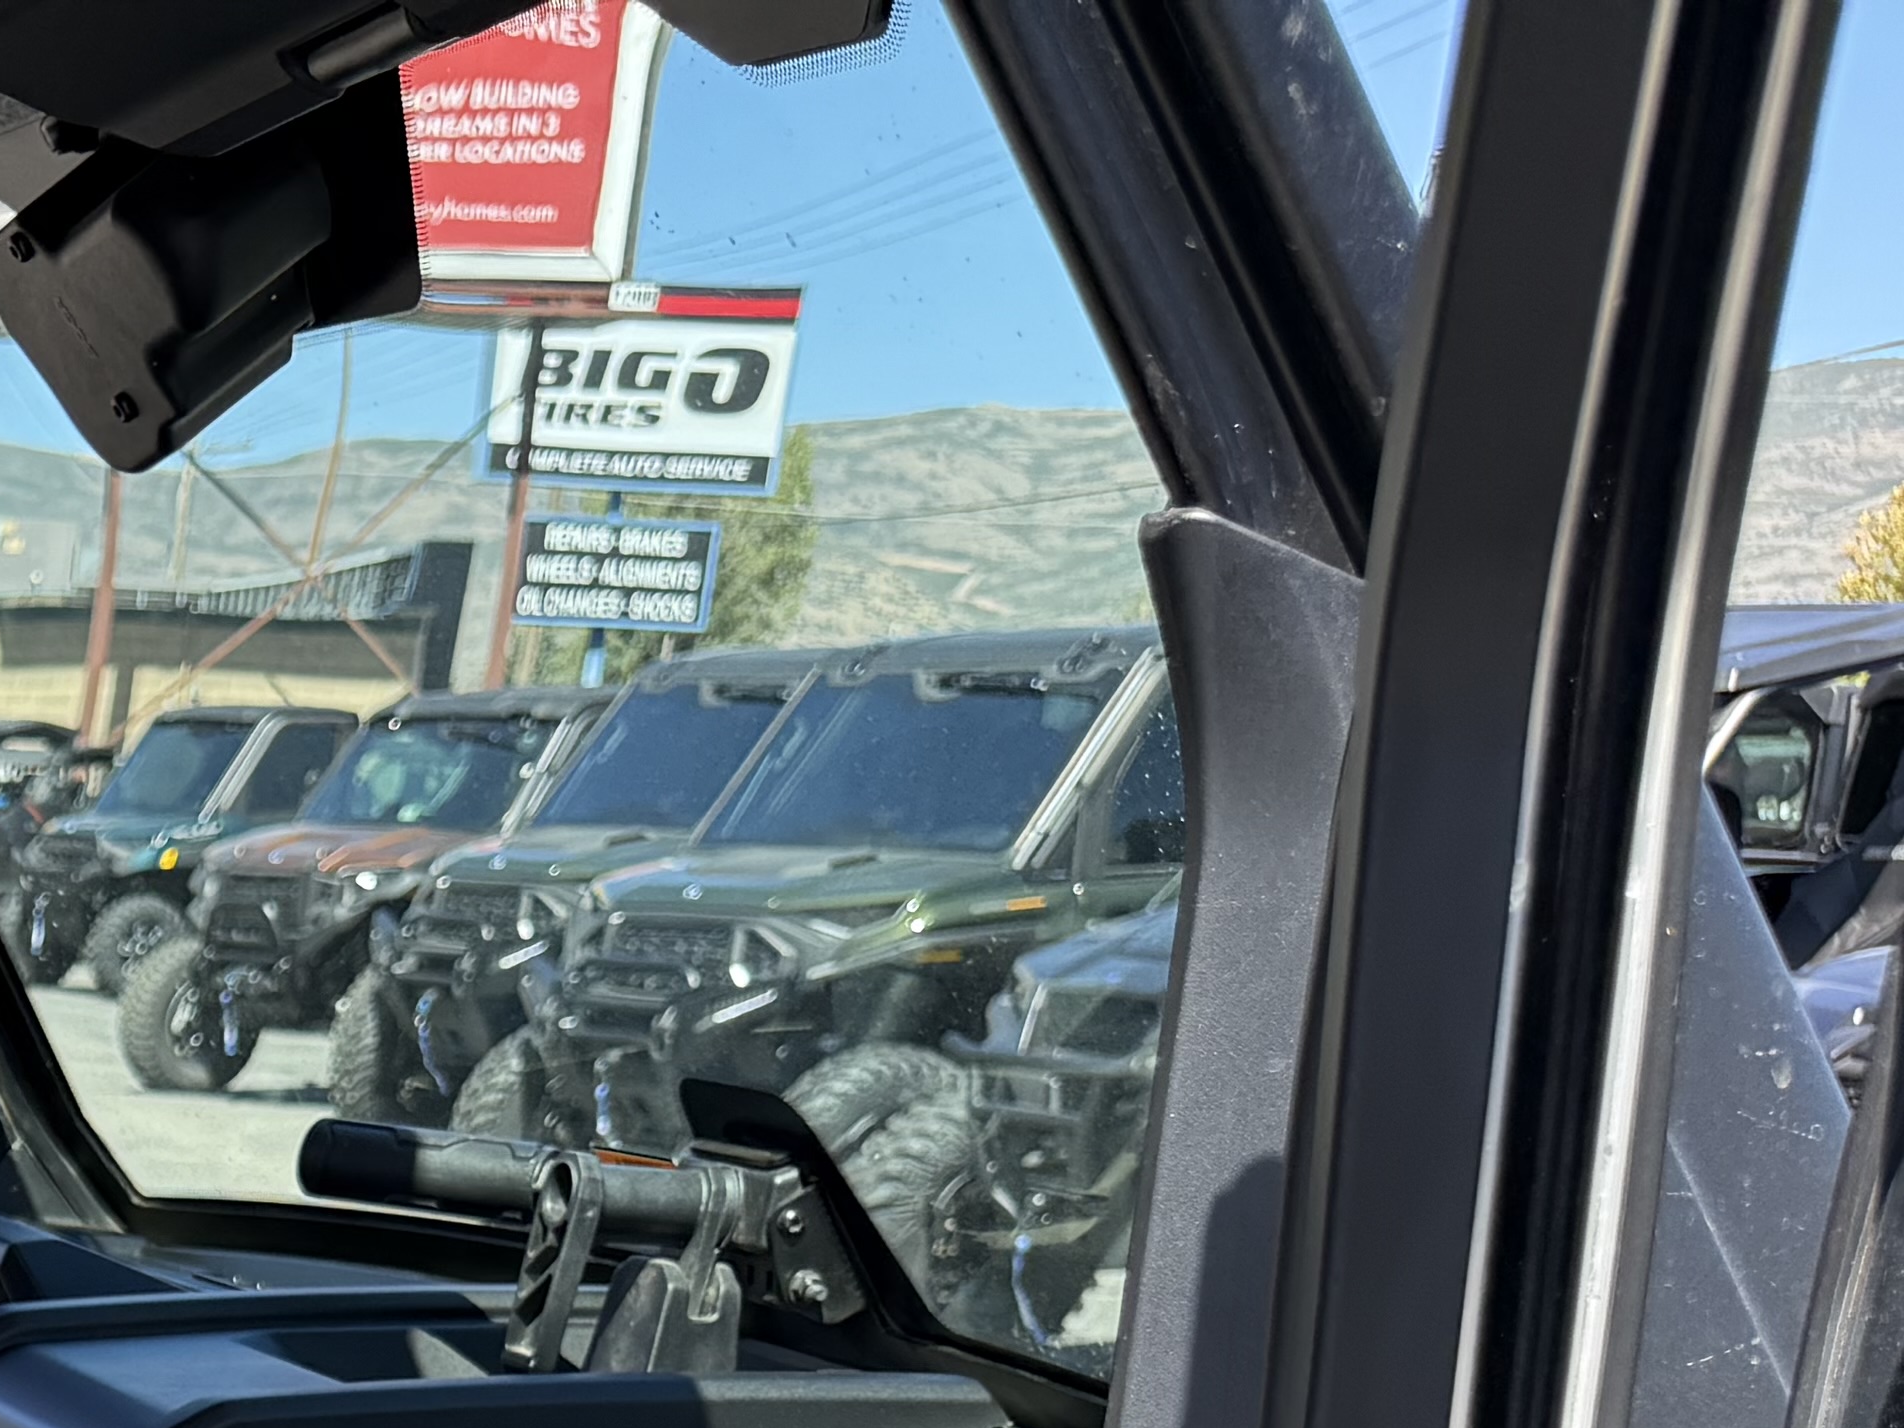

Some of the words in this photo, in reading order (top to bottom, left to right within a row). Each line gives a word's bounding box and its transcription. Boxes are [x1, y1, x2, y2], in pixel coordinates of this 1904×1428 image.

[406, 80, 469, 113] OW
[469, 78, 580, 109] BUILDING
[511, 111, 541, 137] IN
[454, 138, 586, 164] LOCATIONS
[536, 349, 678, 391] BIG
[683, 347, 770, 414] O
[542, 401, 662, 426] IRES
[505, 447, 609, 475] CMPLETE
[608, 453, 664, 478] AUTO
[663, 455, 753, 481] SERVICE
[619, 526, 688, 558] BRAKES
[526, 553, 595, 585] WHEELS
[599, 557, 702, 591] ALIGNMENTS
[516, 584, 543, 616] OIL
[544, 586, 622, 619] CHANGES
[628, 591, 698, 623] SHOCKS
